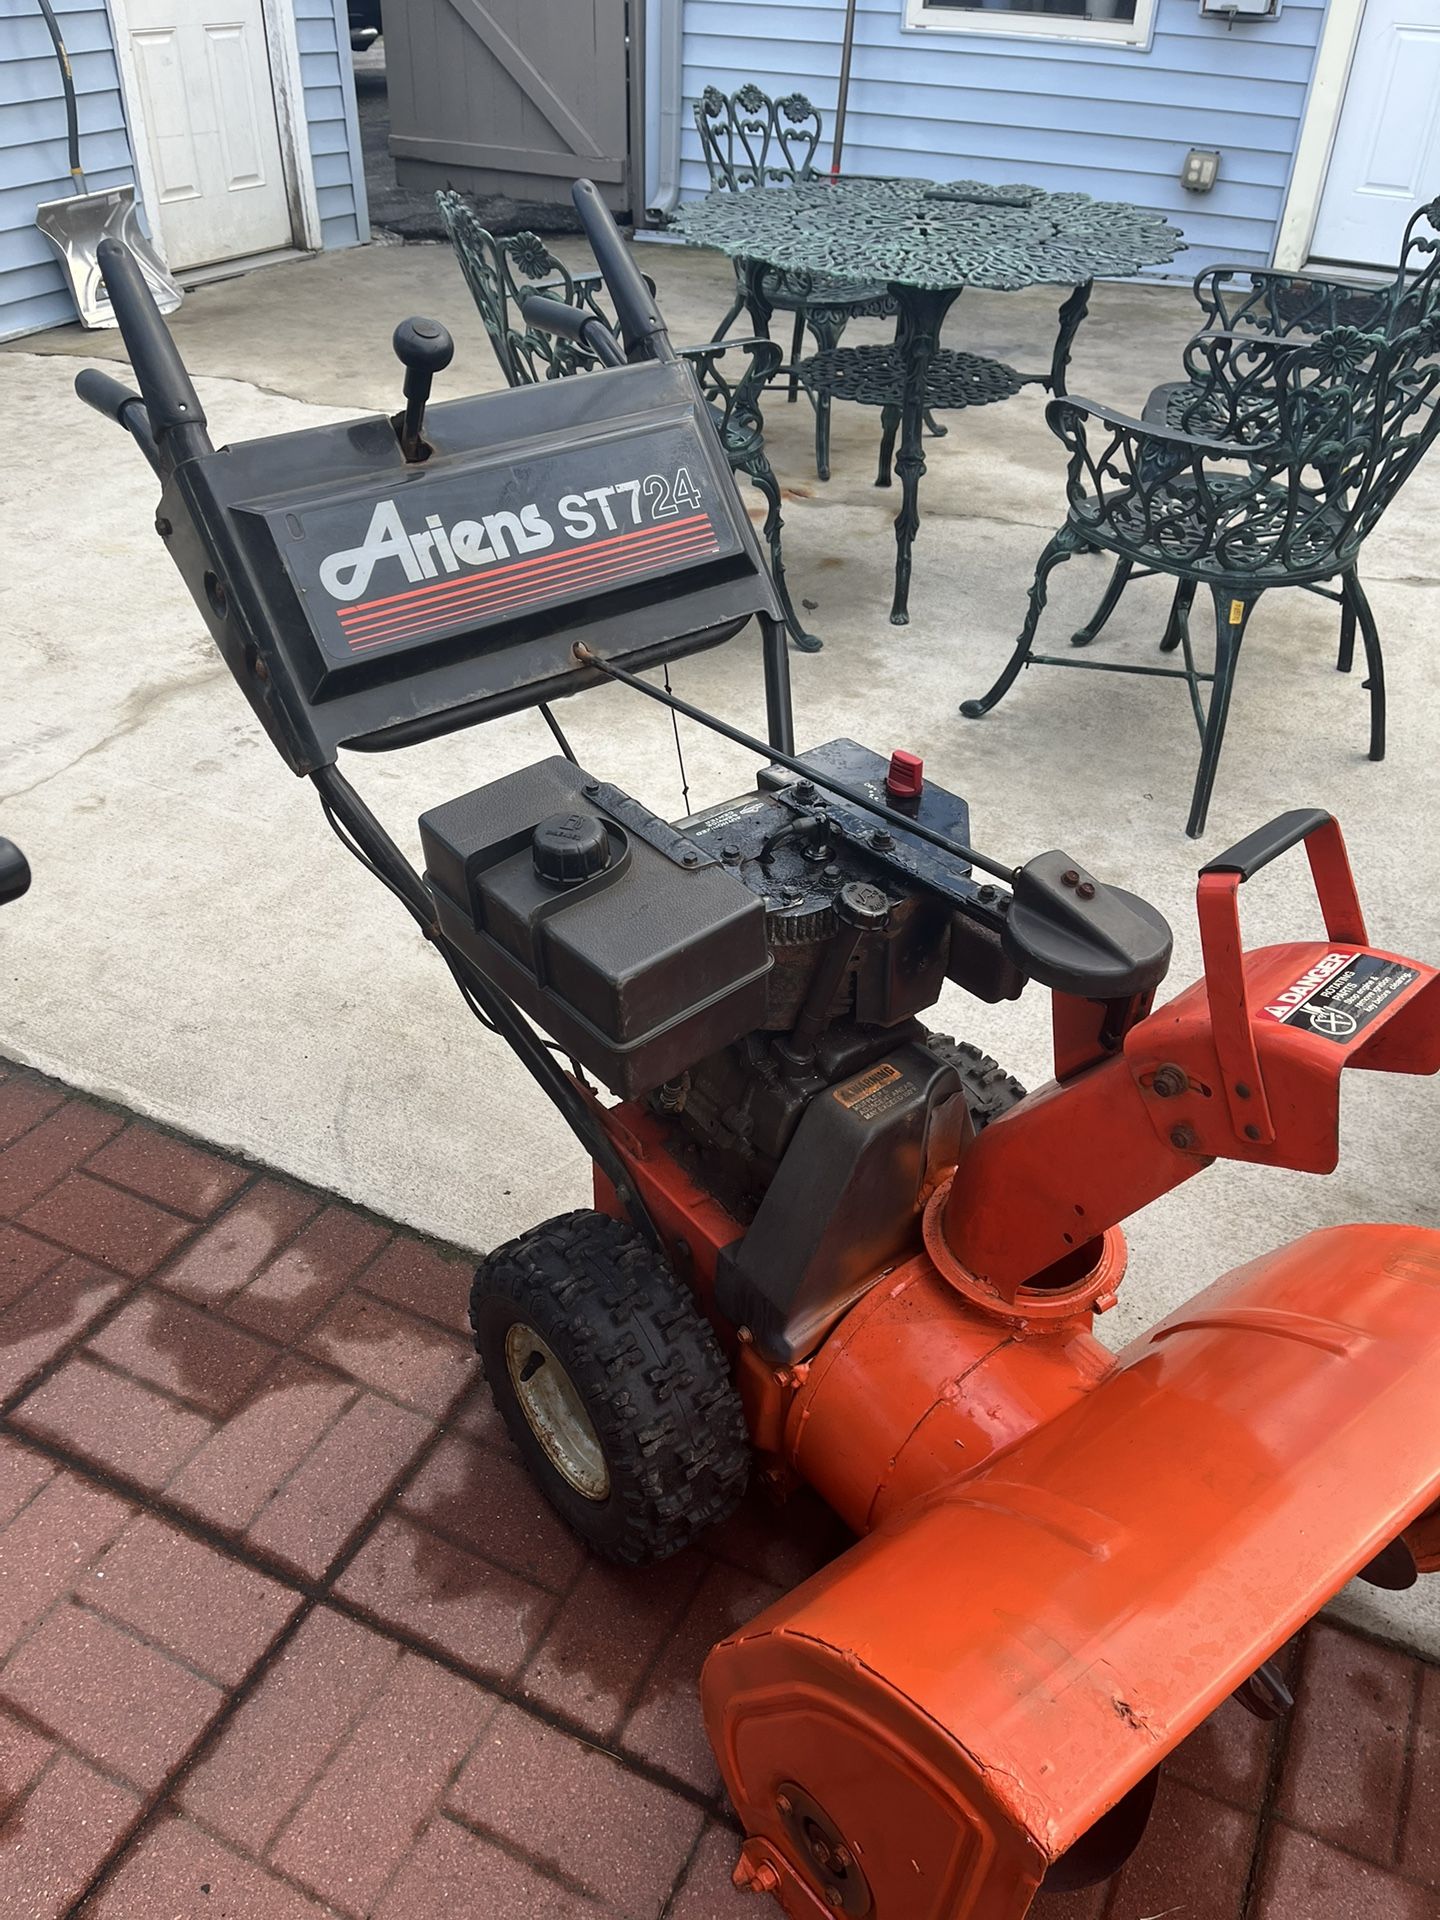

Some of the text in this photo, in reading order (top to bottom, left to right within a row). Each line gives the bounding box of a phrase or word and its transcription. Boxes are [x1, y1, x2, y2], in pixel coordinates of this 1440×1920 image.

[319, 467, 703, 601] Ariens ST724
[1276, 952, 1352, 1005] DANGER
[1320, 971, 1355, 998] ROTATING
[1332, 982, 1358, 1001] PARTS
[1343, 993, 1360, 1005] Stop
[1356, 979, 1375, 995] engine
[1354, 990, 1375, 1008] remove
[1371, 976, 1393, 993] ignition
[1374, 989, 1391, 1004] before
[848, 1066, 895, 1093] WARNING
[863, 1109, 878, 1120] MAY
